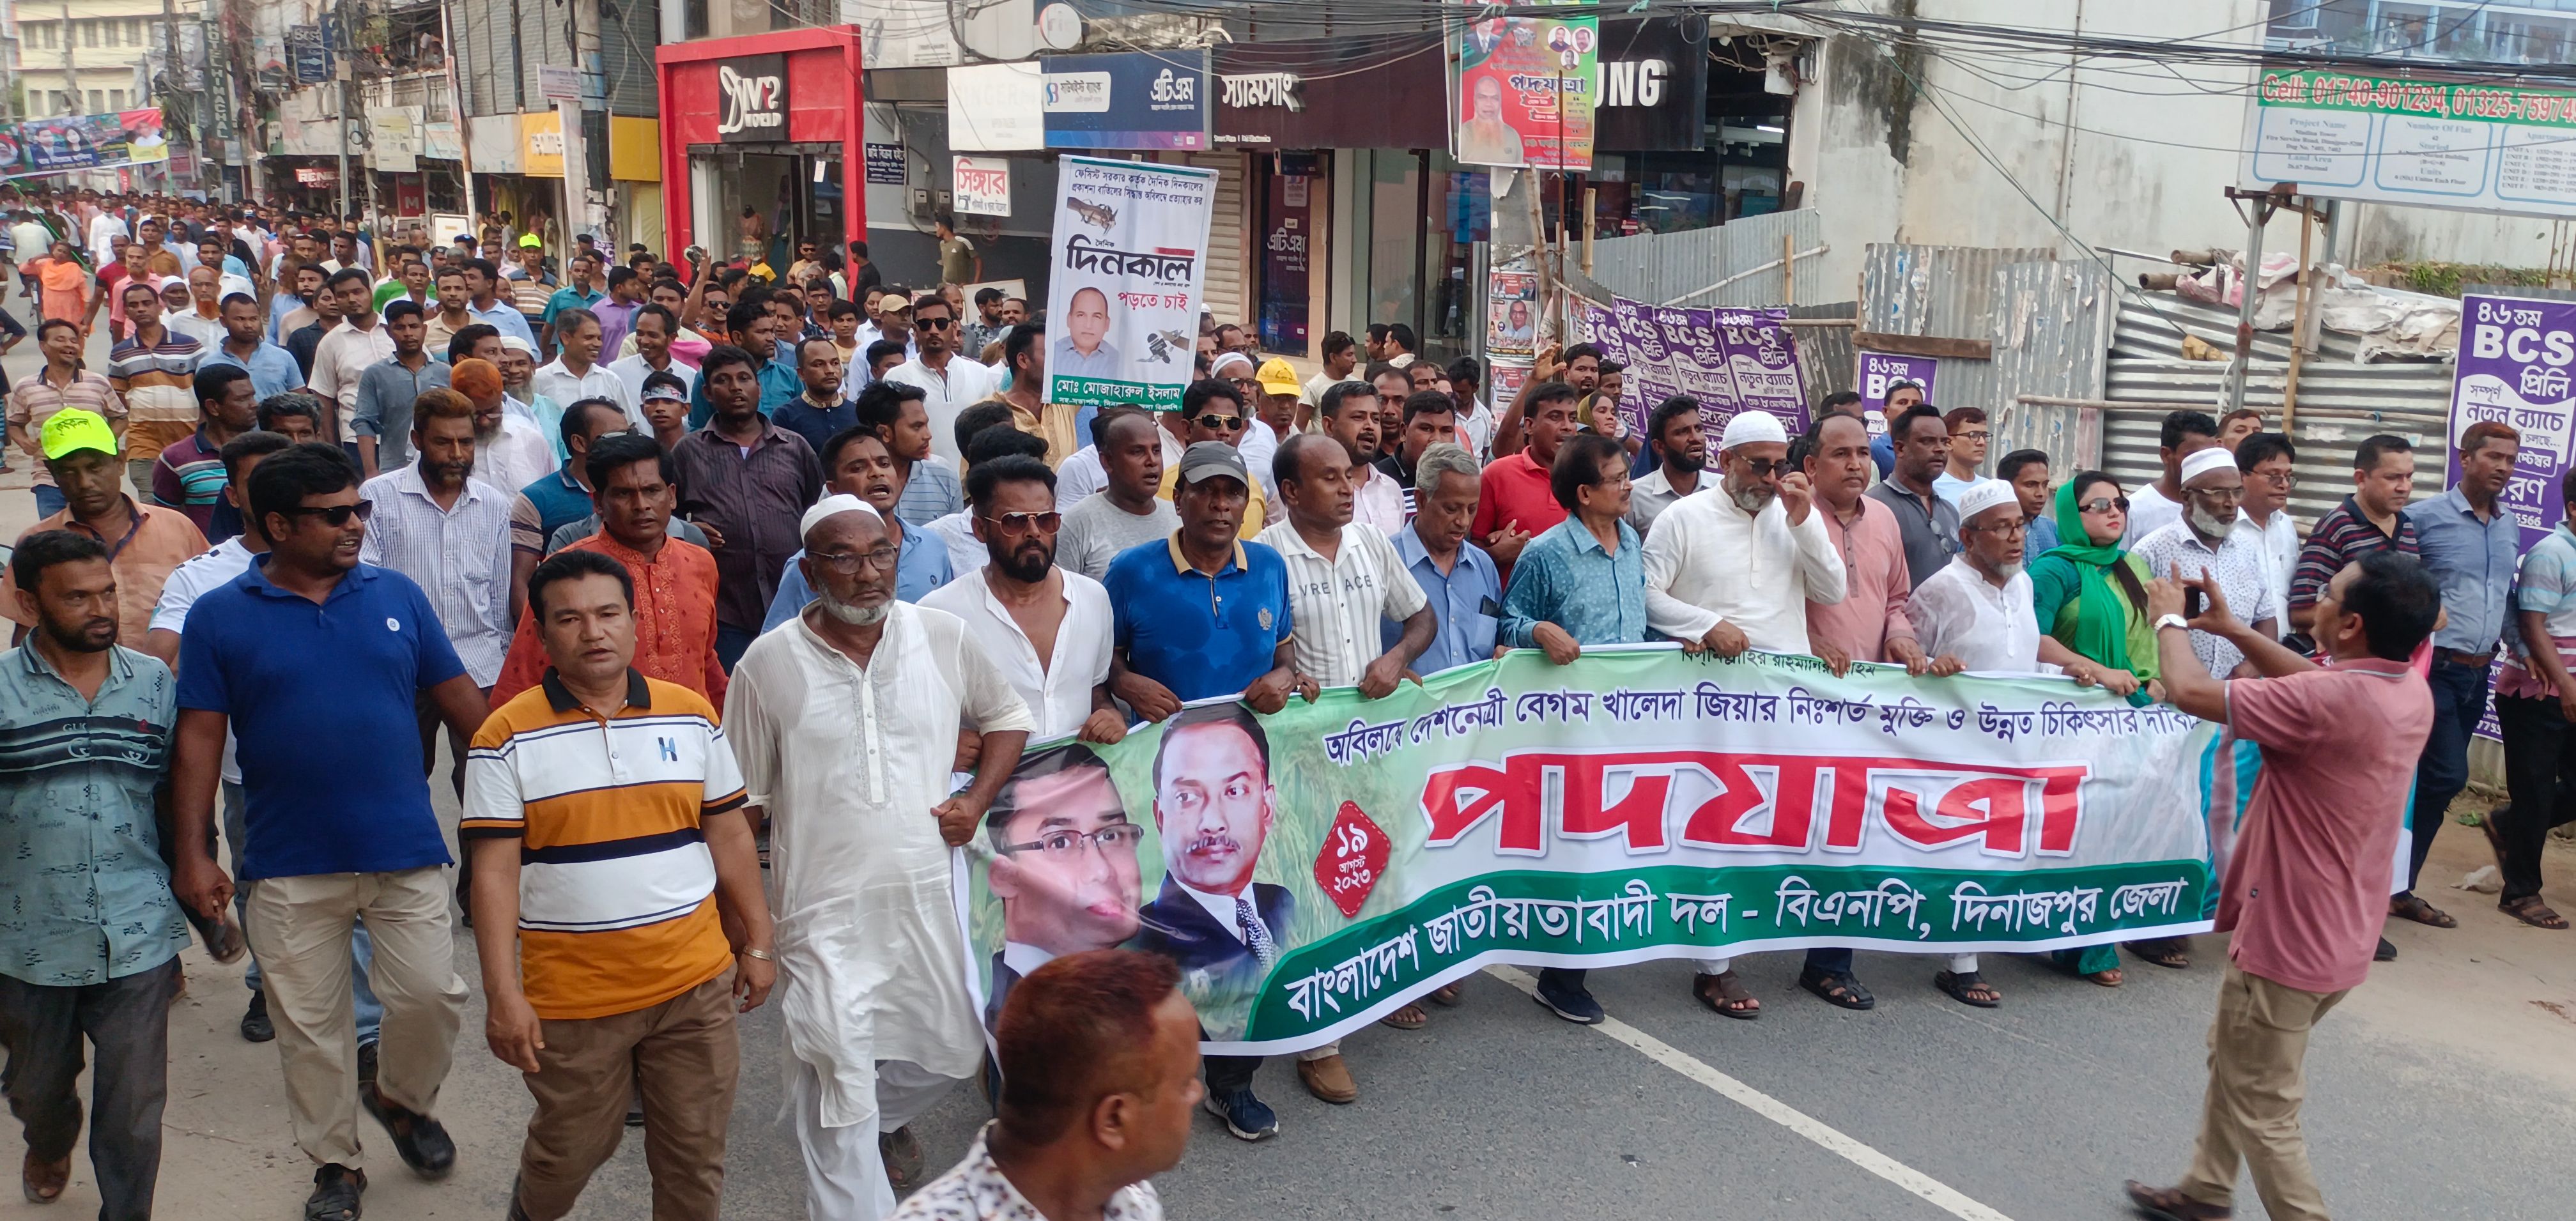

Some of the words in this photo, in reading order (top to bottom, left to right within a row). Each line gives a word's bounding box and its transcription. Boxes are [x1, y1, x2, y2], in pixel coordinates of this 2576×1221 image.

[206, 22, 222, 67] HOTEL
[1151, 68, 1194, 102] এটিএম
[1221, 73, 1293, 112] স্যামসাং
[2262, 73, 2307, 103] Cell:
[211, 69, 228, 138] HIMACHAL
[956, 158, 1006, 196] সিঙ্গার
[1103, 172, 1125, 183] সরকার
[1148, 175, 1169, 188] দৈনিক
[1067, 234, 1194, 282] দিনকাল
[1164, 293, 1189, 312] চাই
[2478, 302, 2543, 328] ৪৬তম
[1584, 323, 1623, 347] BCS
[1616, 313, 1658, 339] BCS
[1662, 324, 1715, 348] BCS
[1724, 325, 1777, 348] BCS
[2473, 324, 2574, 367] BCS
[1738, 372, 1763, 388] নতুন
[1764, 374, 1793, 385] ব্যাচে
[1869, 358, 1909, 376] ৪৬তম
[2520, 365, 2571, 399] প্রিলি
[1057, 380, 1078, 394] মোঃ
[1083, 381, 1144, 399] মোজাহারুল
[1148, 384, 1180, 401] ইসলাম
[2515, 407, 2566, 431] ব্যাচে
[1325, 718, 1407, 764] অবিলম্বে
[1411, 688, 1508, 744] দেশনেত্রী
[1516, 689, 1594, 723] বেগম
[1603, 687, 1685, 722] খালেদা
[1693, 681, 1781, 724] জিয়ার
[1789, 686, 1873, 725] নিঃশর্ত
[1879, 696, 1934, 737] মুক্তি
[1947, 711, 1966, 730] ও
[1978, 702, 2033, 744] উন্নত
[2041, 702, 2139, 737] চিকিৎসার
[1420, 752, 2091, 854] পদযাত্রা
[1337, 822, 1368, 857] ১৯
[1334, 869, 1371, 895] ২০২৩
[1284, 924, 1419, 1022] বাংলাদেশ
[1425, 879, 1658, 955] জাতীয়তাবাদী
[1665, 893, 1732, 935] দল
[1775, 875, 1931, 940] বিএনপি,
[1950, 880, 2102, 937] দিনাজপুর
[2110, 877, 2189, 919] জেলা
